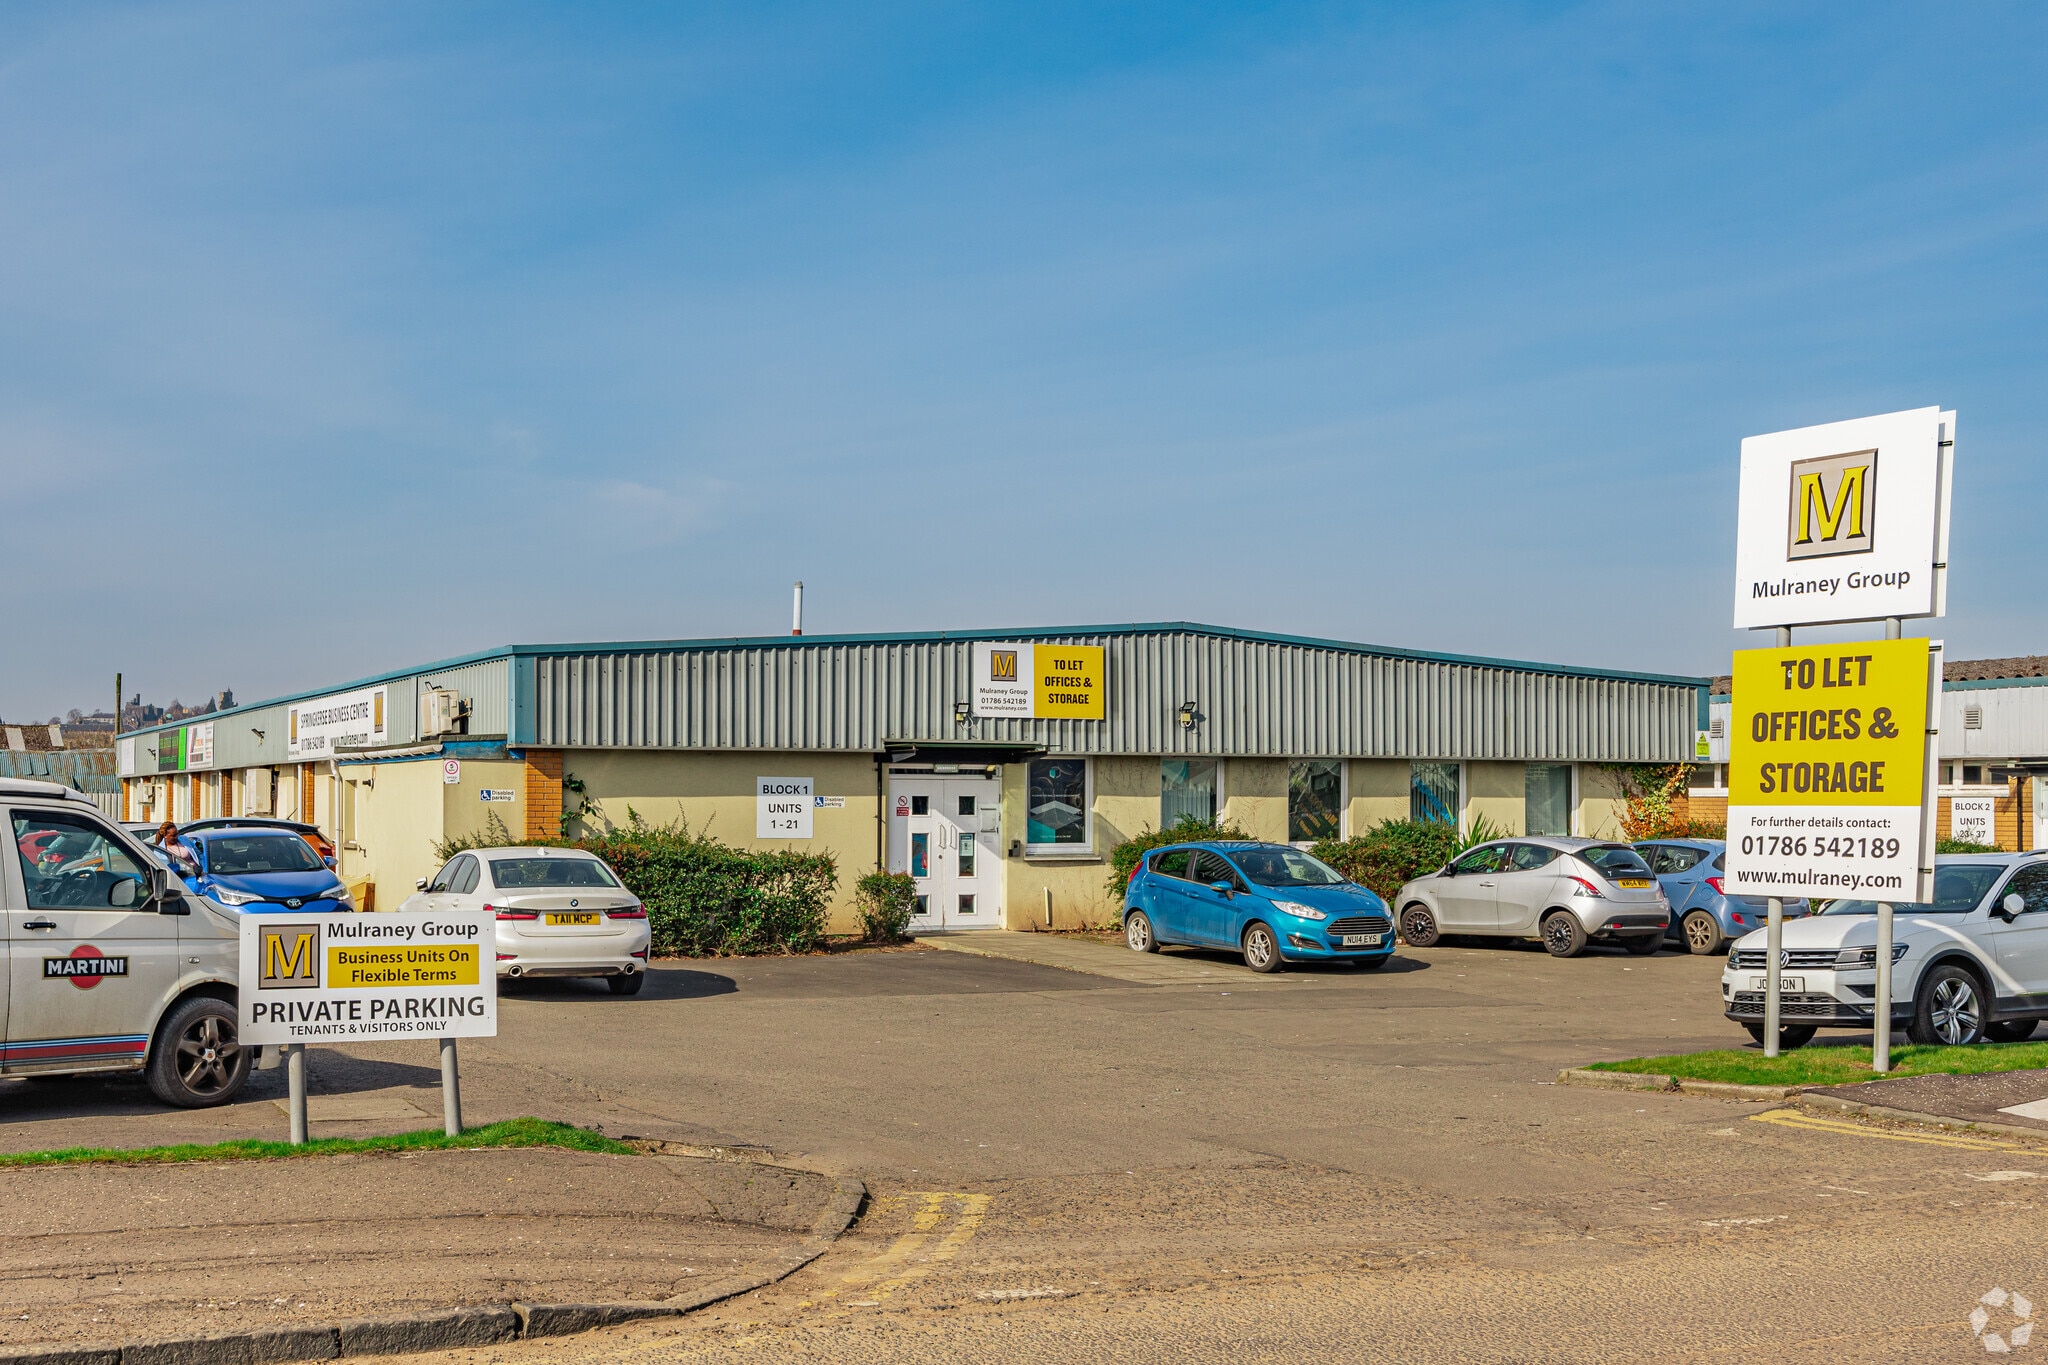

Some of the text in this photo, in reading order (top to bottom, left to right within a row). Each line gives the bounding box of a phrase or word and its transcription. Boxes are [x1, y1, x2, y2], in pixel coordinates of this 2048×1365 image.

[1752, 569, 1911, 599] Mulraney Group
[1054, 660, 1083, 670] TO LET
[1781, 655, 1872, 690] TO LET
[1045, 676, 1093, 688] OFFICES &
[1009, 688, 1028, 696] Group
[1048, 693, 1089, 704] STORAGE
[328, 706, 349, 725] BUSINESS
[350, 702, 368, 721] CENTRE
[1752, 707, 1899, 743] OFFICES &
[1760, 761, 1885, 793] STORAGE
[762, 785, 808, 795] BLOCK 1
[768, 804, 802, 813] UNITS
[1955, 802, 1991, 811] BLOCK 2
[771, 819, 777, 829] 1
[786, 820, 798, 829] 21
[1751, 816, 1892, 829] For further details contact:
[1959, 818, 1986, 826] UNITS
[1976, 830, 1986, 838] 37
[1741, 835, 1901, 859] 01786 542189
[1737, 868, 1902, 891] www.mulraney.com
[573, 914, 593, 924] MCP
[327, 921, 479, 941] Mulraney Group
[338, 948, 469, 965] Business Units On
[47, 959, 124, 975] MARTINI
[351, 968, 457, 983] Flexible Terms
[252, 996, 485, 1024] PRIVATE PARKING
[289, 1020, 448, 1036] TENANTS & VISITORS ONLY
